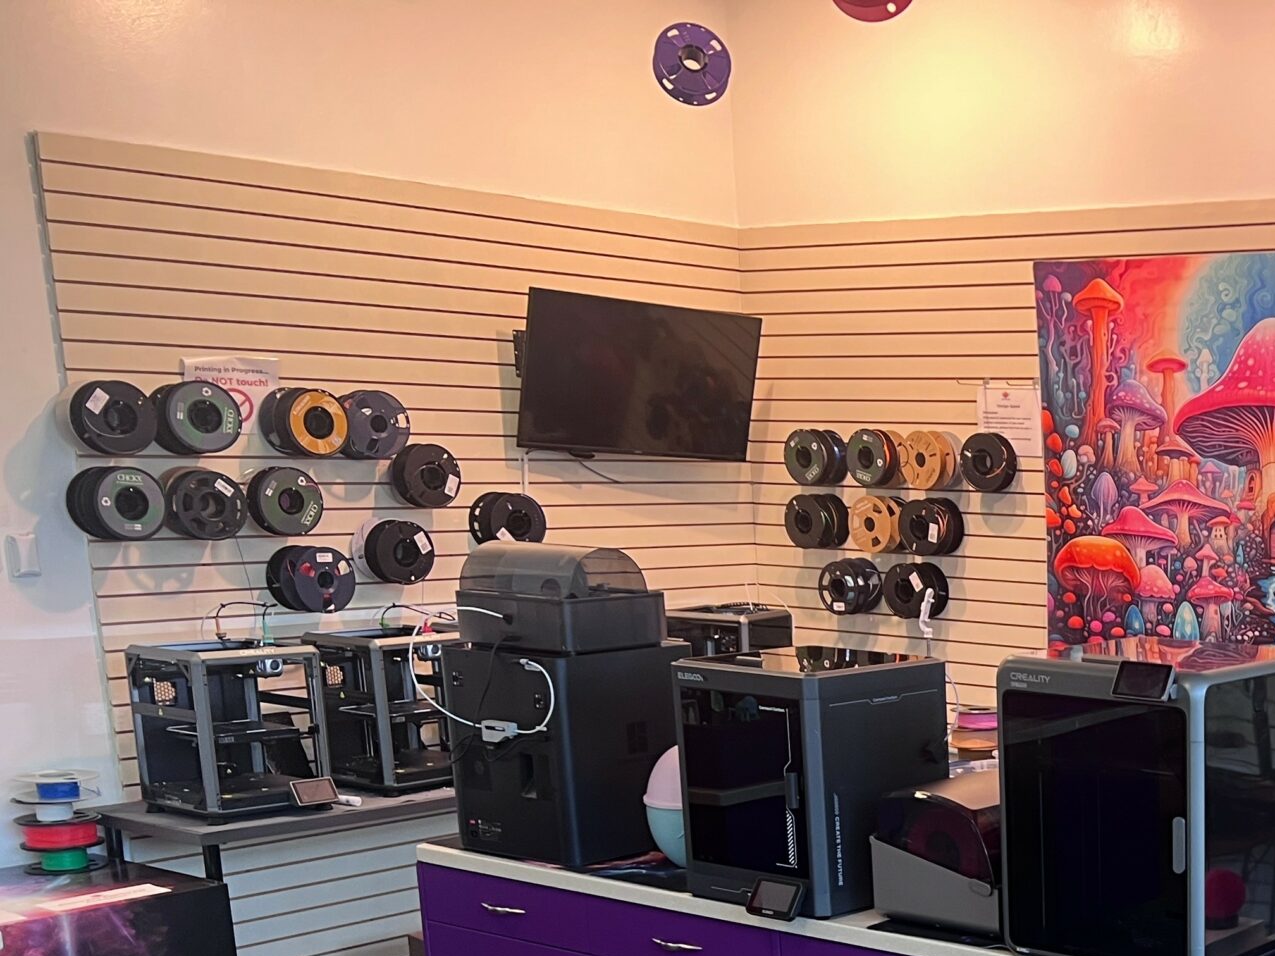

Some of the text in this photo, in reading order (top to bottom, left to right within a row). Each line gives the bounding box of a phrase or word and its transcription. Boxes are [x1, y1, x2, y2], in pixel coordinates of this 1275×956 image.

[211, 377, 233, 385] NOT
[236, 378, 269, 387] touch!
[1010, 672, 1051, 683] CREALITY
